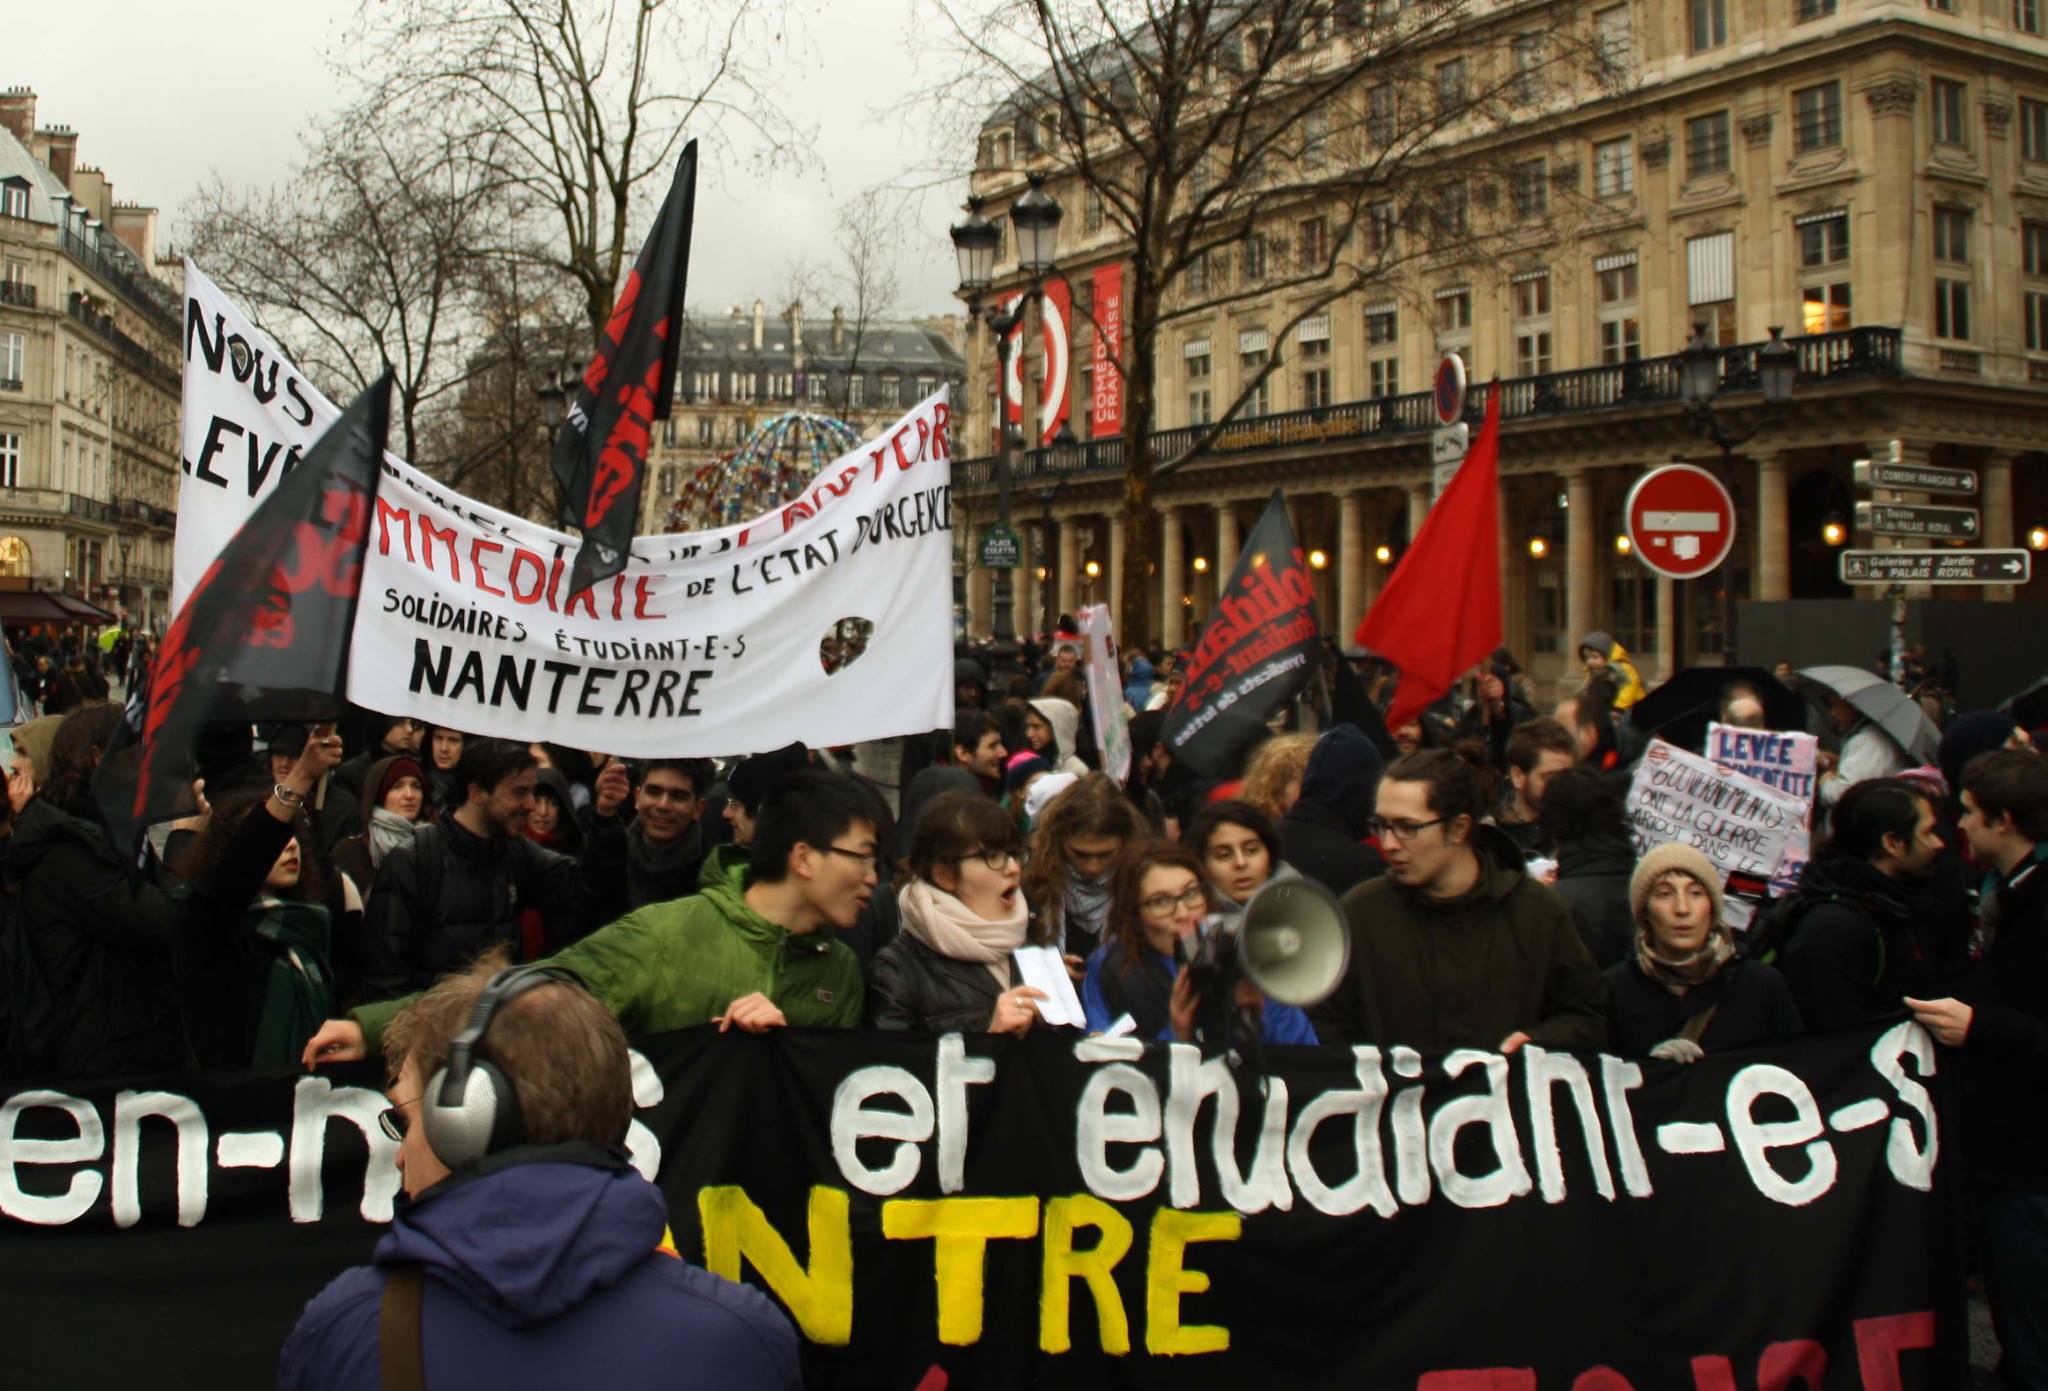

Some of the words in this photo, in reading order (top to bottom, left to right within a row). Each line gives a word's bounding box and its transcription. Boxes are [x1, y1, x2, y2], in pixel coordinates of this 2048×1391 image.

[187, 297, 314, 427] NOUS
[686, 577, 716, 599] DE
[1870, 557, 1914, 566] Galeries
[1920, 557, 1932, 566] et
[1941, 556, 1975, 566] Jardin
[1870, 568, 1884, 578] du
[1889, 568, 1931, 578] PALAIS
[1938, 568, 1976, 578] ROYAL
[408, 637, 714, 719] NANTERRE
[1640, 788, 1672, 812] ONT
[1673, 801, 1692, 824] LA
[1694, 810, 1770, 857] GUERRE
[1689, 832, 1731, 861] DANS
[1738, 855, 1766, 873] LE
[829, 1031, 996, 1196] et
